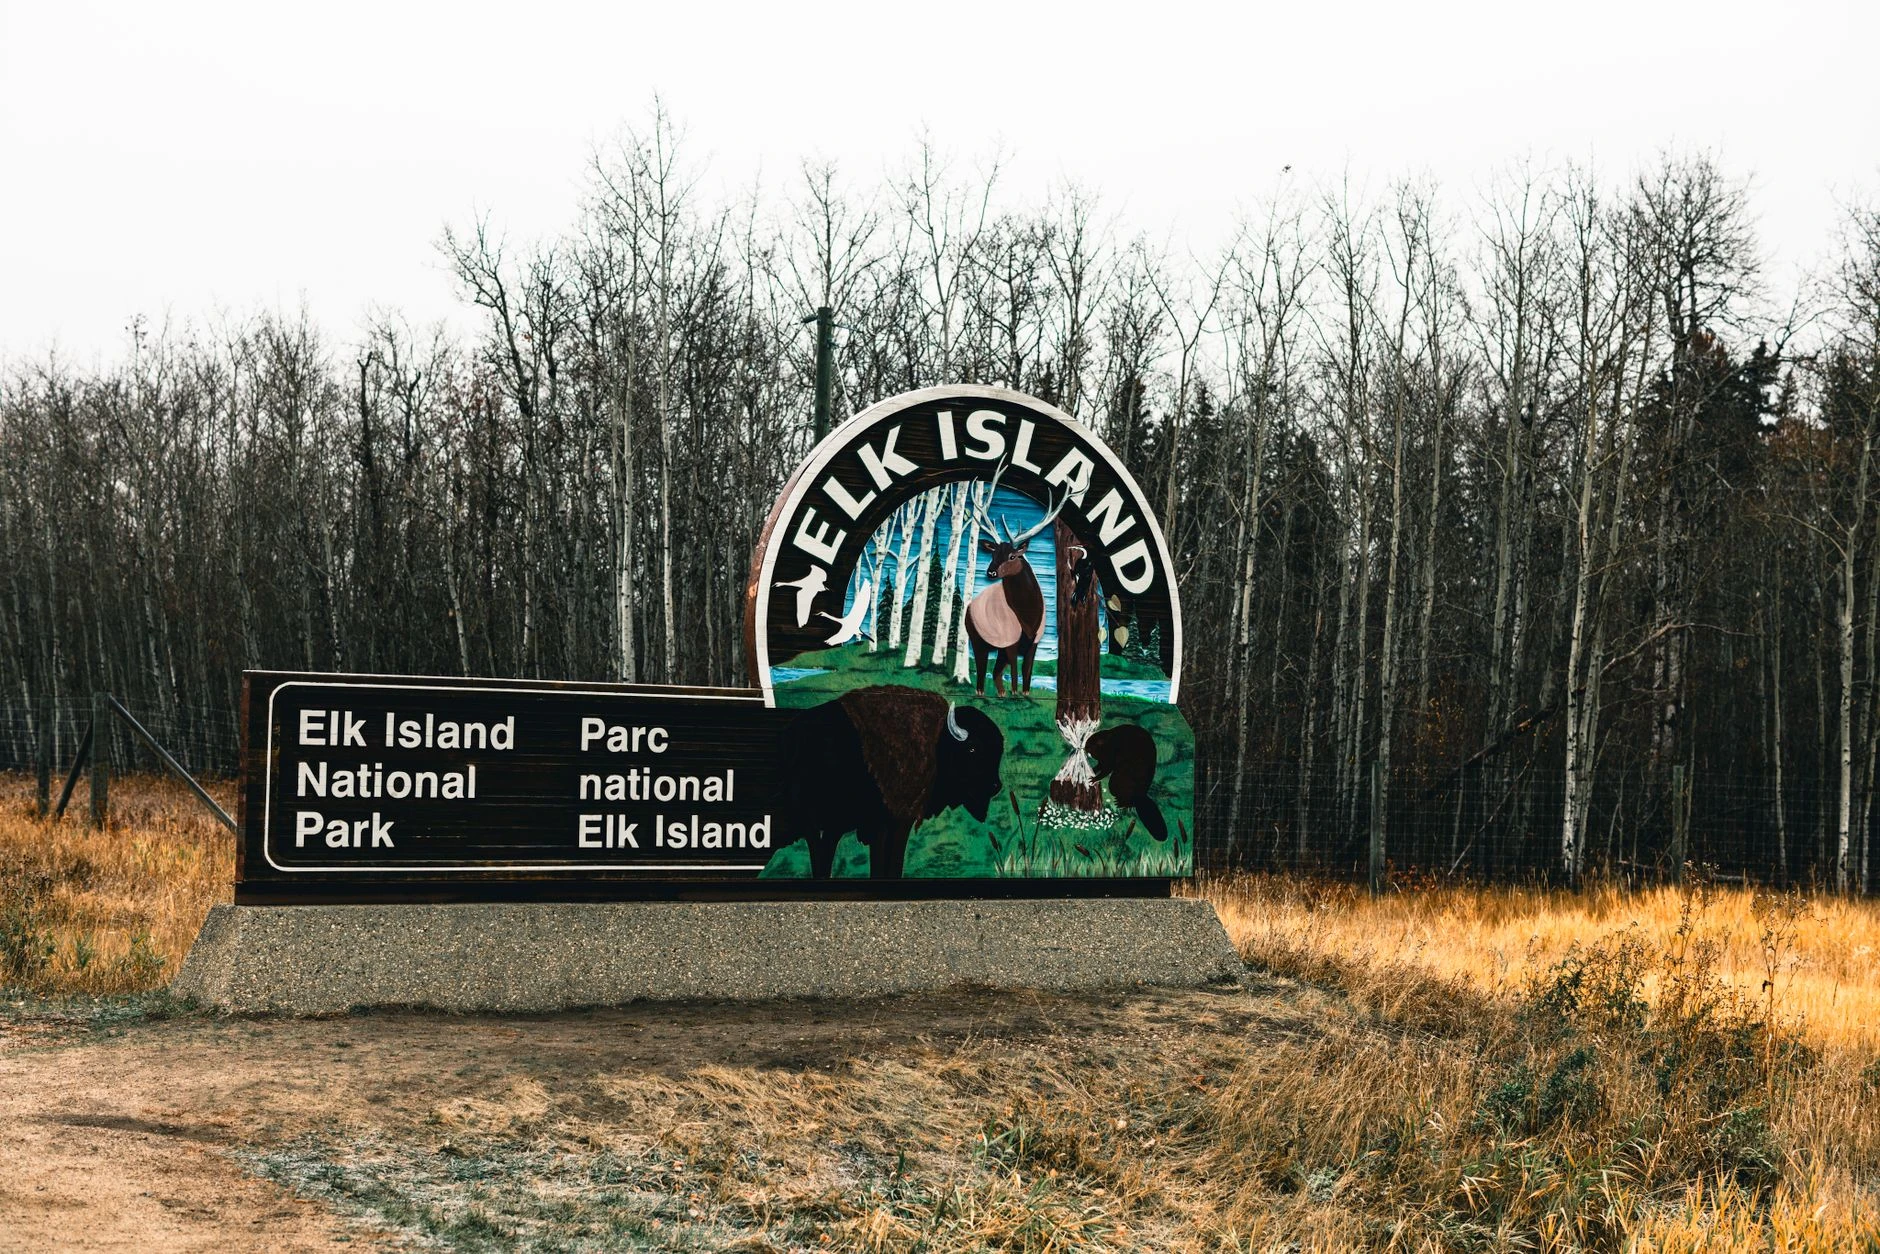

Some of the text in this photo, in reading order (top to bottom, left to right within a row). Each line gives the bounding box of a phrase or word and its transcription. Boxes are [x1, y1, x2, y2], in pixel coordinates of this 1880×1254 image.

[792, 408, 1155, 595] ELK ISLAND
[299, 709, 515, 751] Elk Island
[581, 717, 669, 754] Parc
[297, 761, 476, 800] National
[579, 766, 734, 802] national
[295, 811, 395, 848] Park
[578, 814, 771, 849] Elk Island
